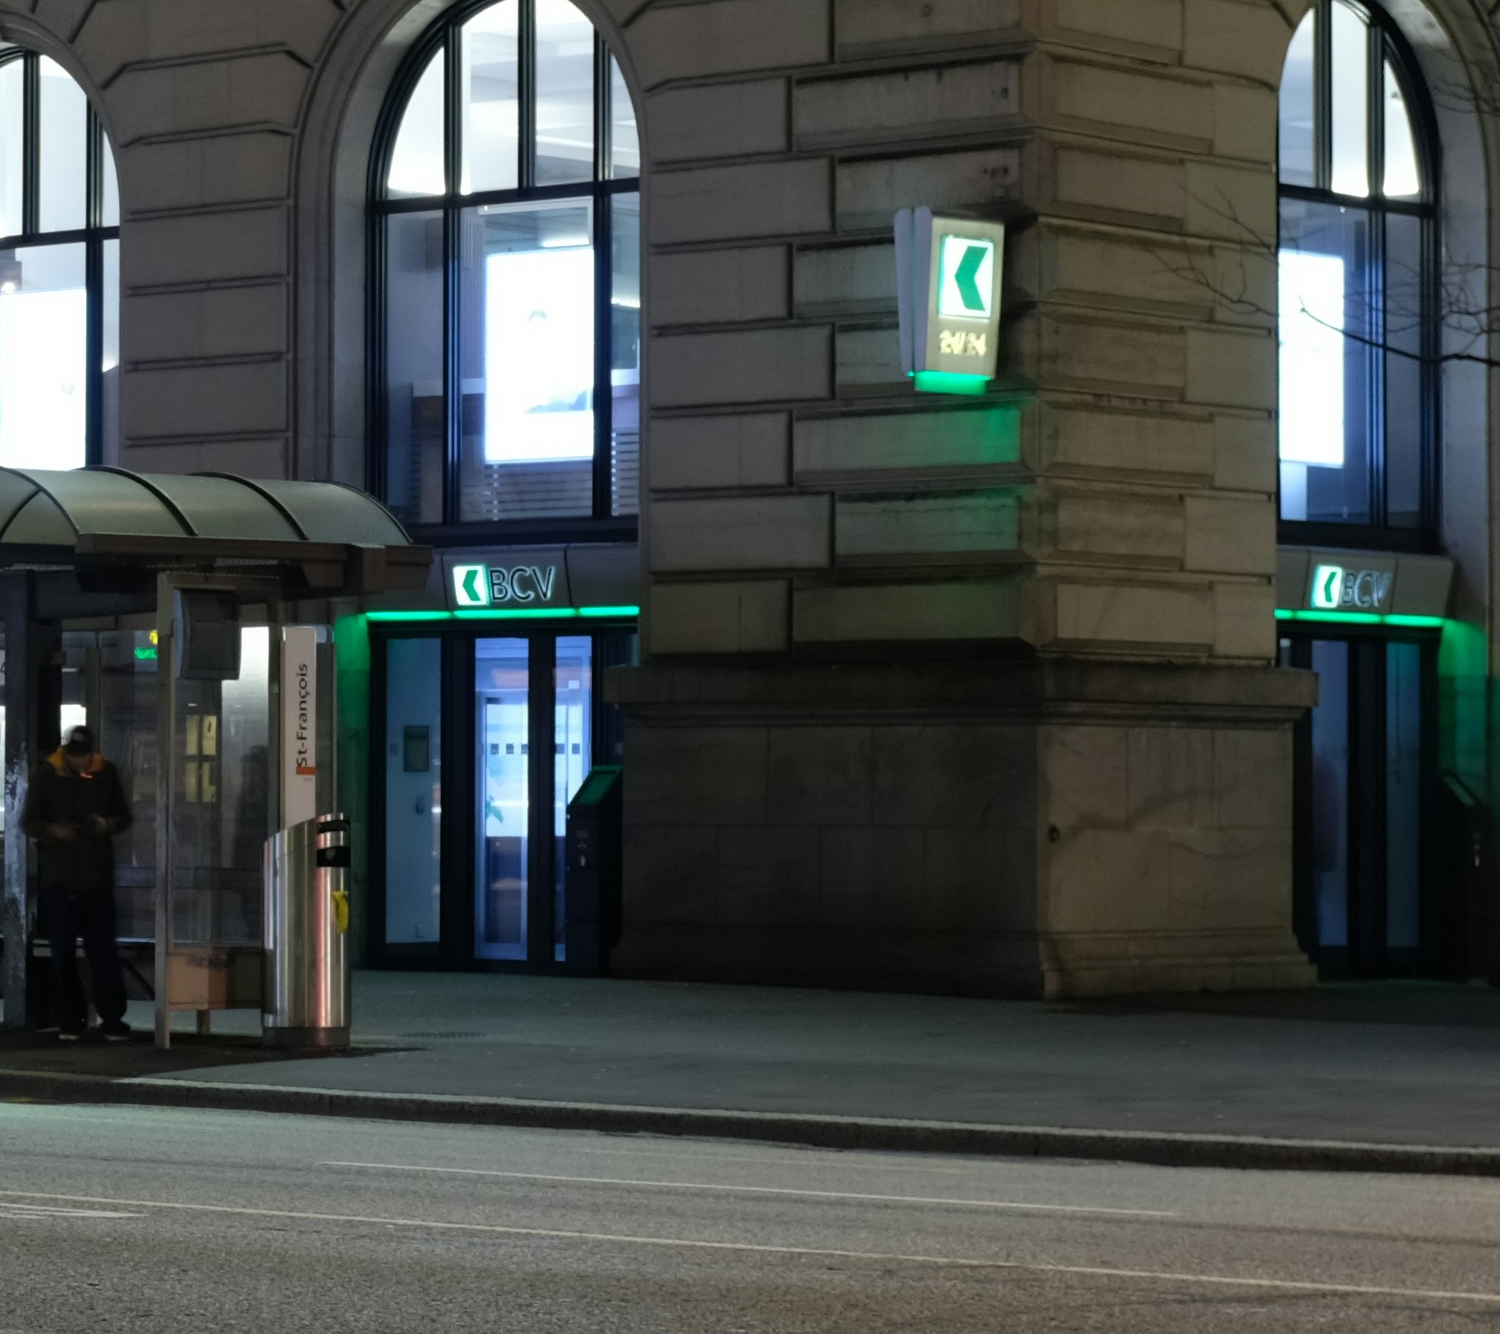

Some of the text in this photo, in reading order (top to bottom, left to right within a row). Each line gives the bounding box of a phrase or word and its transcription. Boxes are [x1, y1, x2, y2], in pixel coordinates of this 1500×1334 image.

[939, 329, 987, 357] 24/24
[489, 565, 555, 602] BCV
[1342, 569, 1393, 607] BCV
[296, 663, 311, 768] St-François
